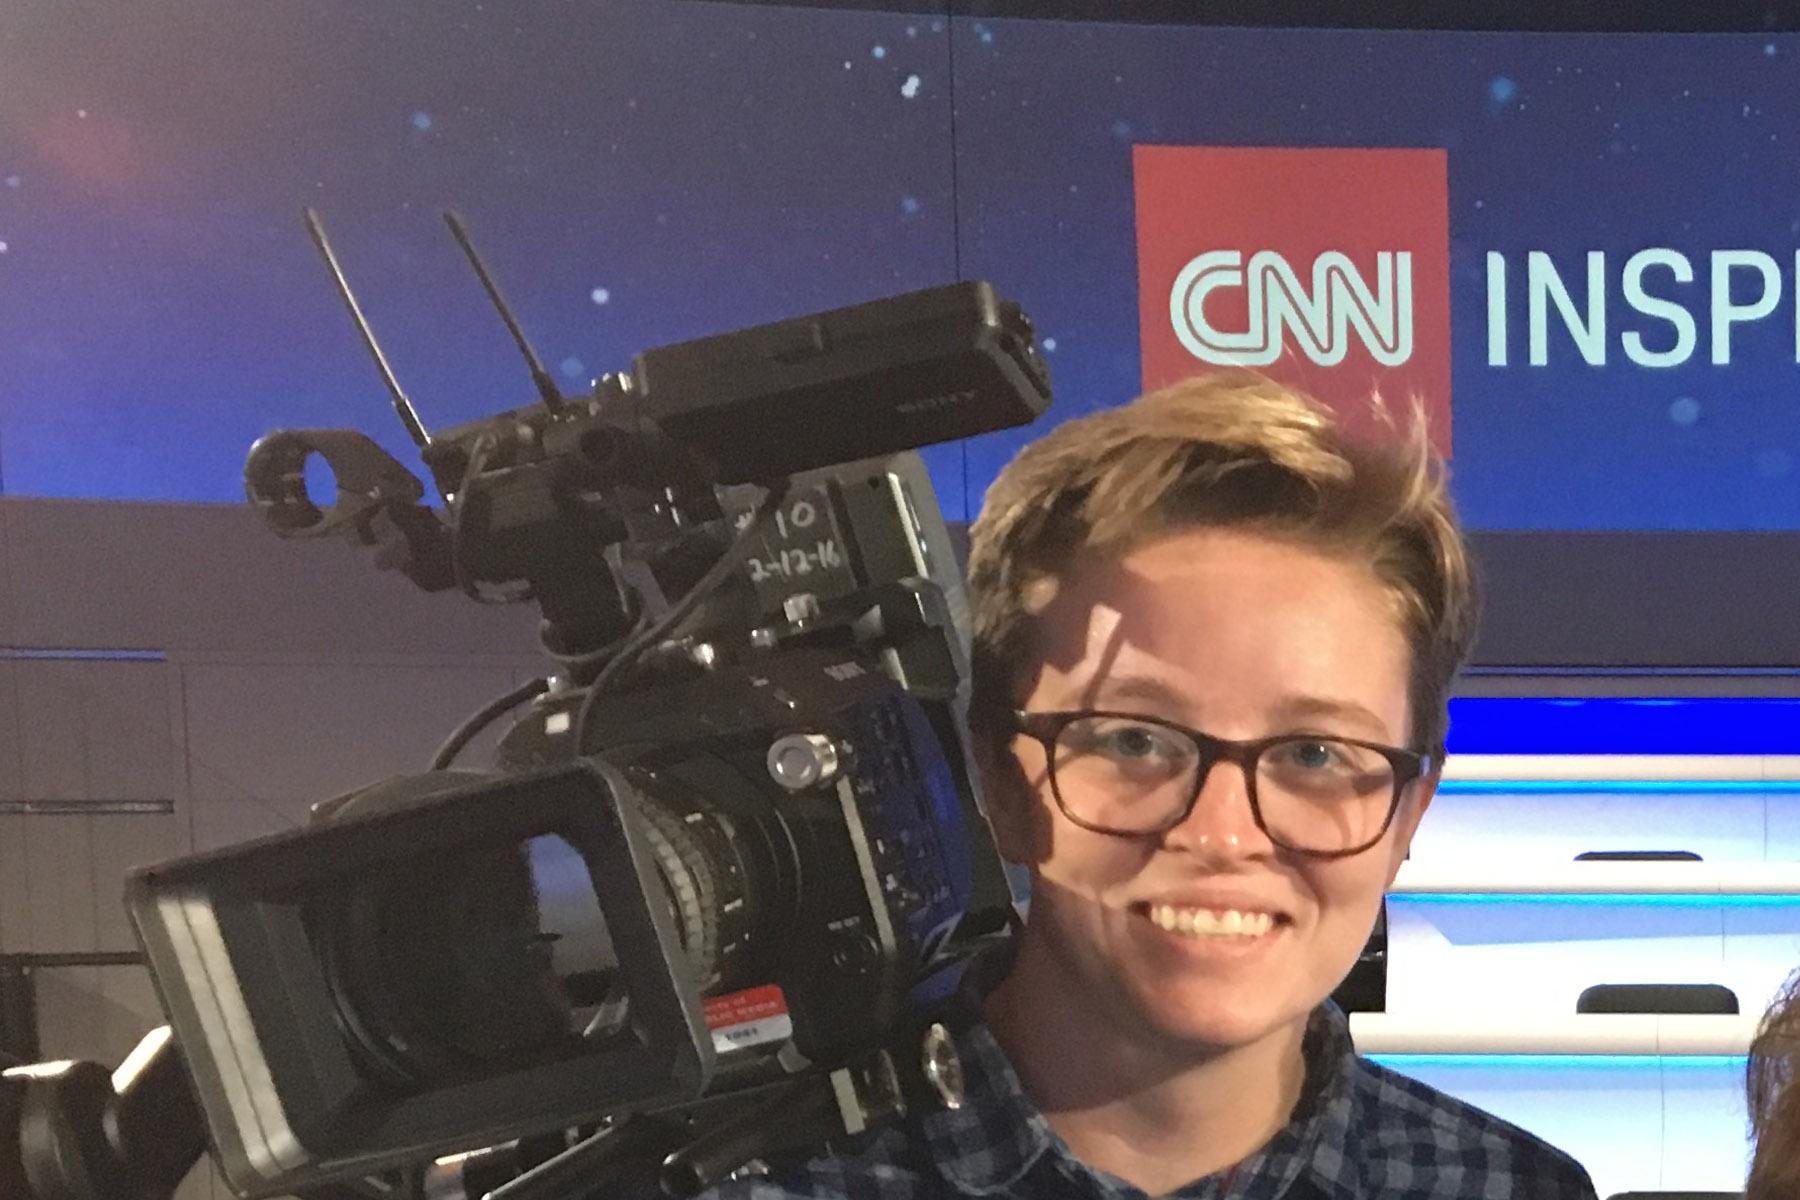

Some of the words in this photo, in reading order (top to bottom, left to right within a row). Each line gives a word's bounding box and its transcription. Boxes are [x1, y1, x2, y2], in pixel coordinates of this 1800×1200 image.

[1169, 251, 1413, 367] CNN
[775, 501, 816, 538] 10
[748, 540, 841, 582] 2-12-16
